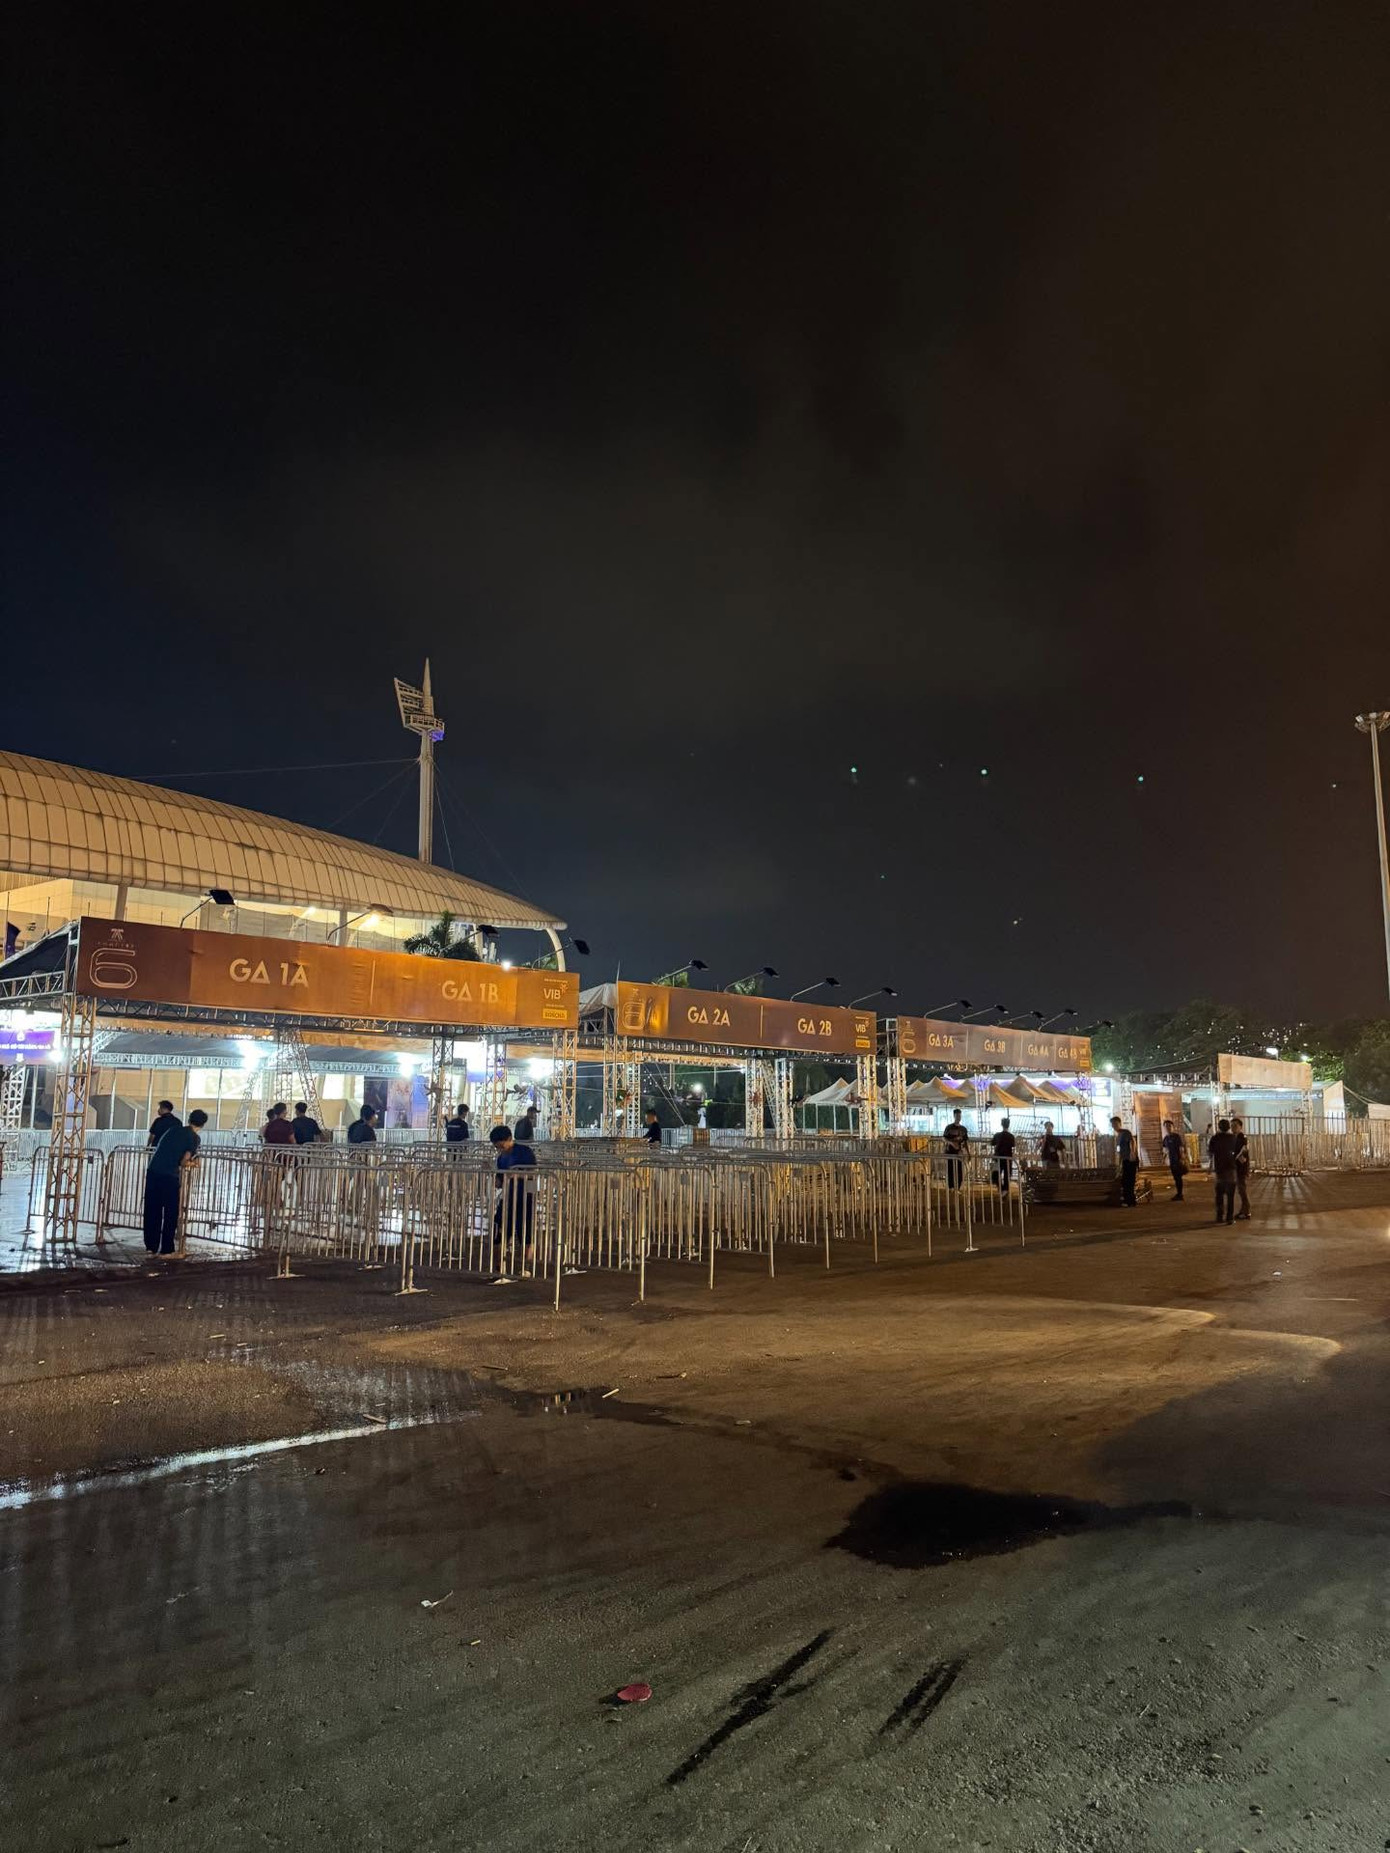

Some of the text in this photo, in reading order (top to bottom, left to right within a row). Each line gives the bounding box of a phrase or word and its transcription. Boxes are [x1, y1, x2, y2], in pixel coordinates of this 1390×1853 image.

[229, 958, 309, 988] GA 1A
[441, 980, 499, 1003] GA 1B
[543, 988, 561, 1000] VIB
[687, 1006, 731, 1027] GA 2A
[797, 1018, 832, 1037] GA 2B
[855, 1024, 867, 1034] VIB
[928, 1033, 954, 1048] GA 3A
[984, 1039, 1006, 1053] GA 3B
[1027, 1044, 1038, 1056] GA
